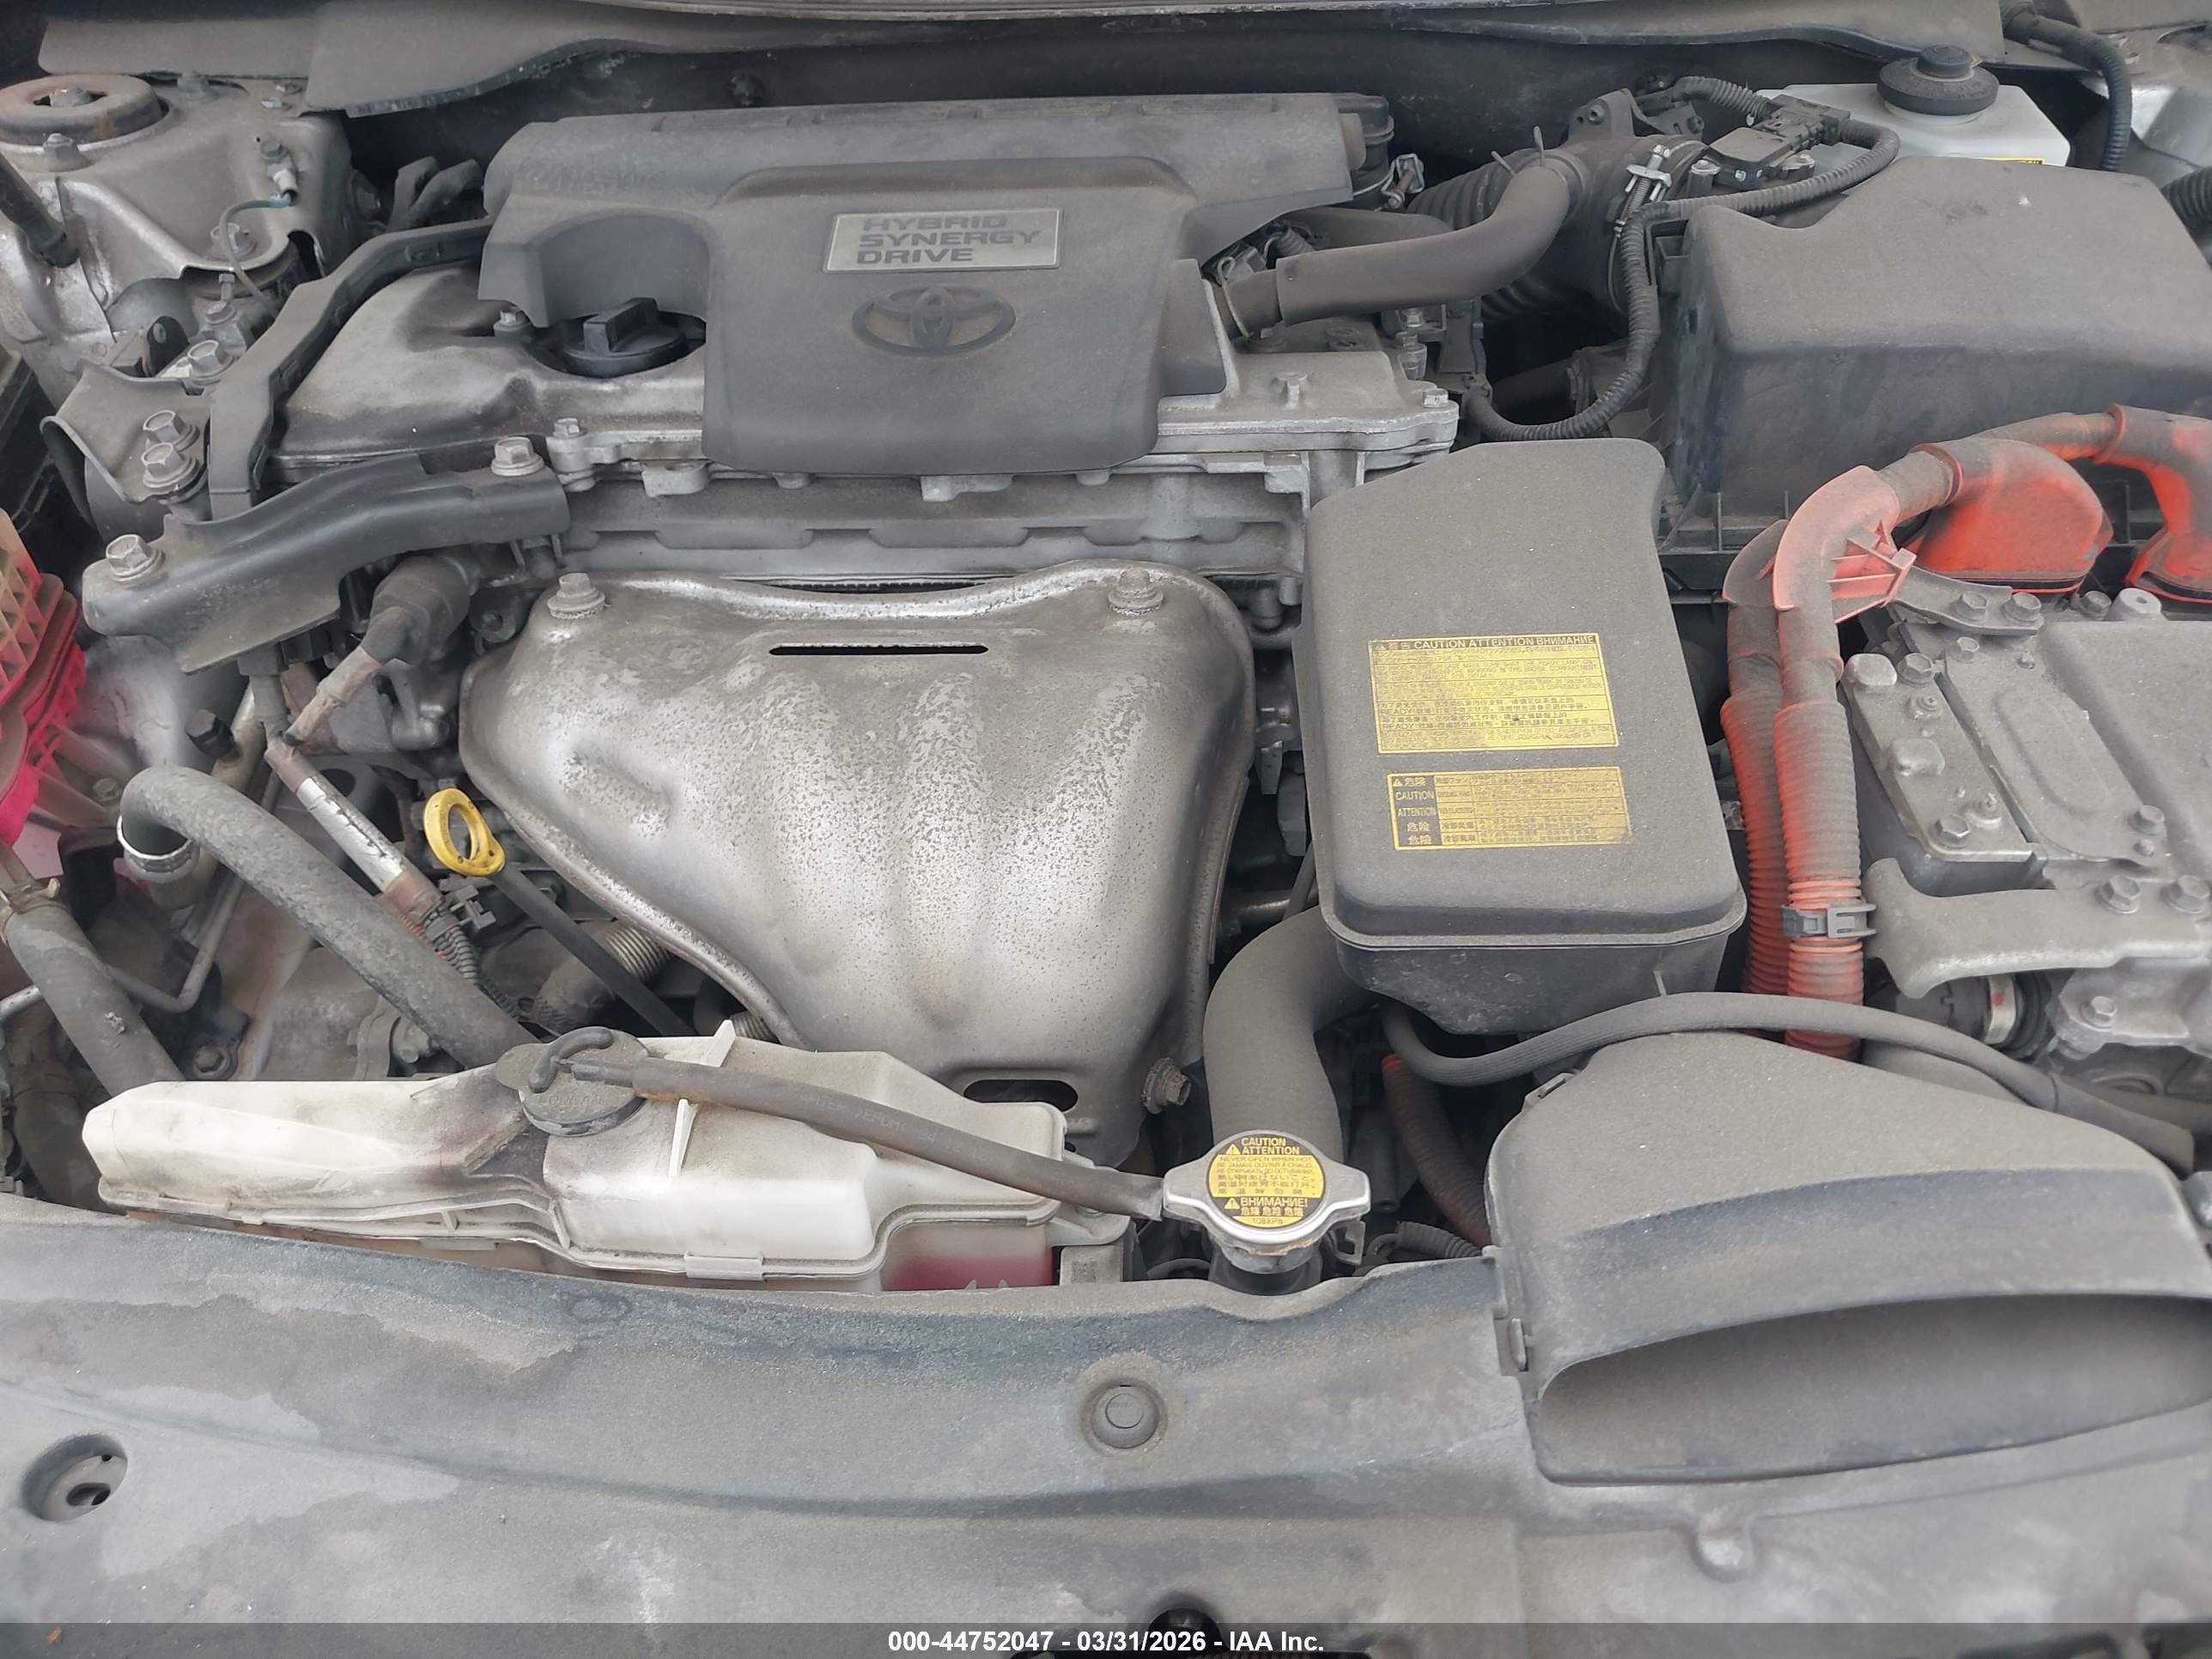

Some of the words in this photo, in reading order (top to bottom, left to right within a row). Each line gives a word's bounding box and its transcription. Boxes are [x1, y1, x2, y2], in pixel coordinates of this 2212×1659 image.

[863, 216, 1007, 231] HYBRID
[860, 230, 1041, 247] SYNERGY
[856, 248, 974, 264] DRIVE
[1414, 639, 1466, 649] CAUTION
[1469, 637, 1534, 648] ATTENTION
[1536, 635, 1595, 646] ВНИМАНИЕ
[1395, 790, 1435, 800] CAUTION
[1241, 1137, 1286, 1146] CAUTION
[1242, 1146, 1300, 1155] ATTENTION
[1240, 1197, 1308, 1207] ВНИМАНИЕ!
